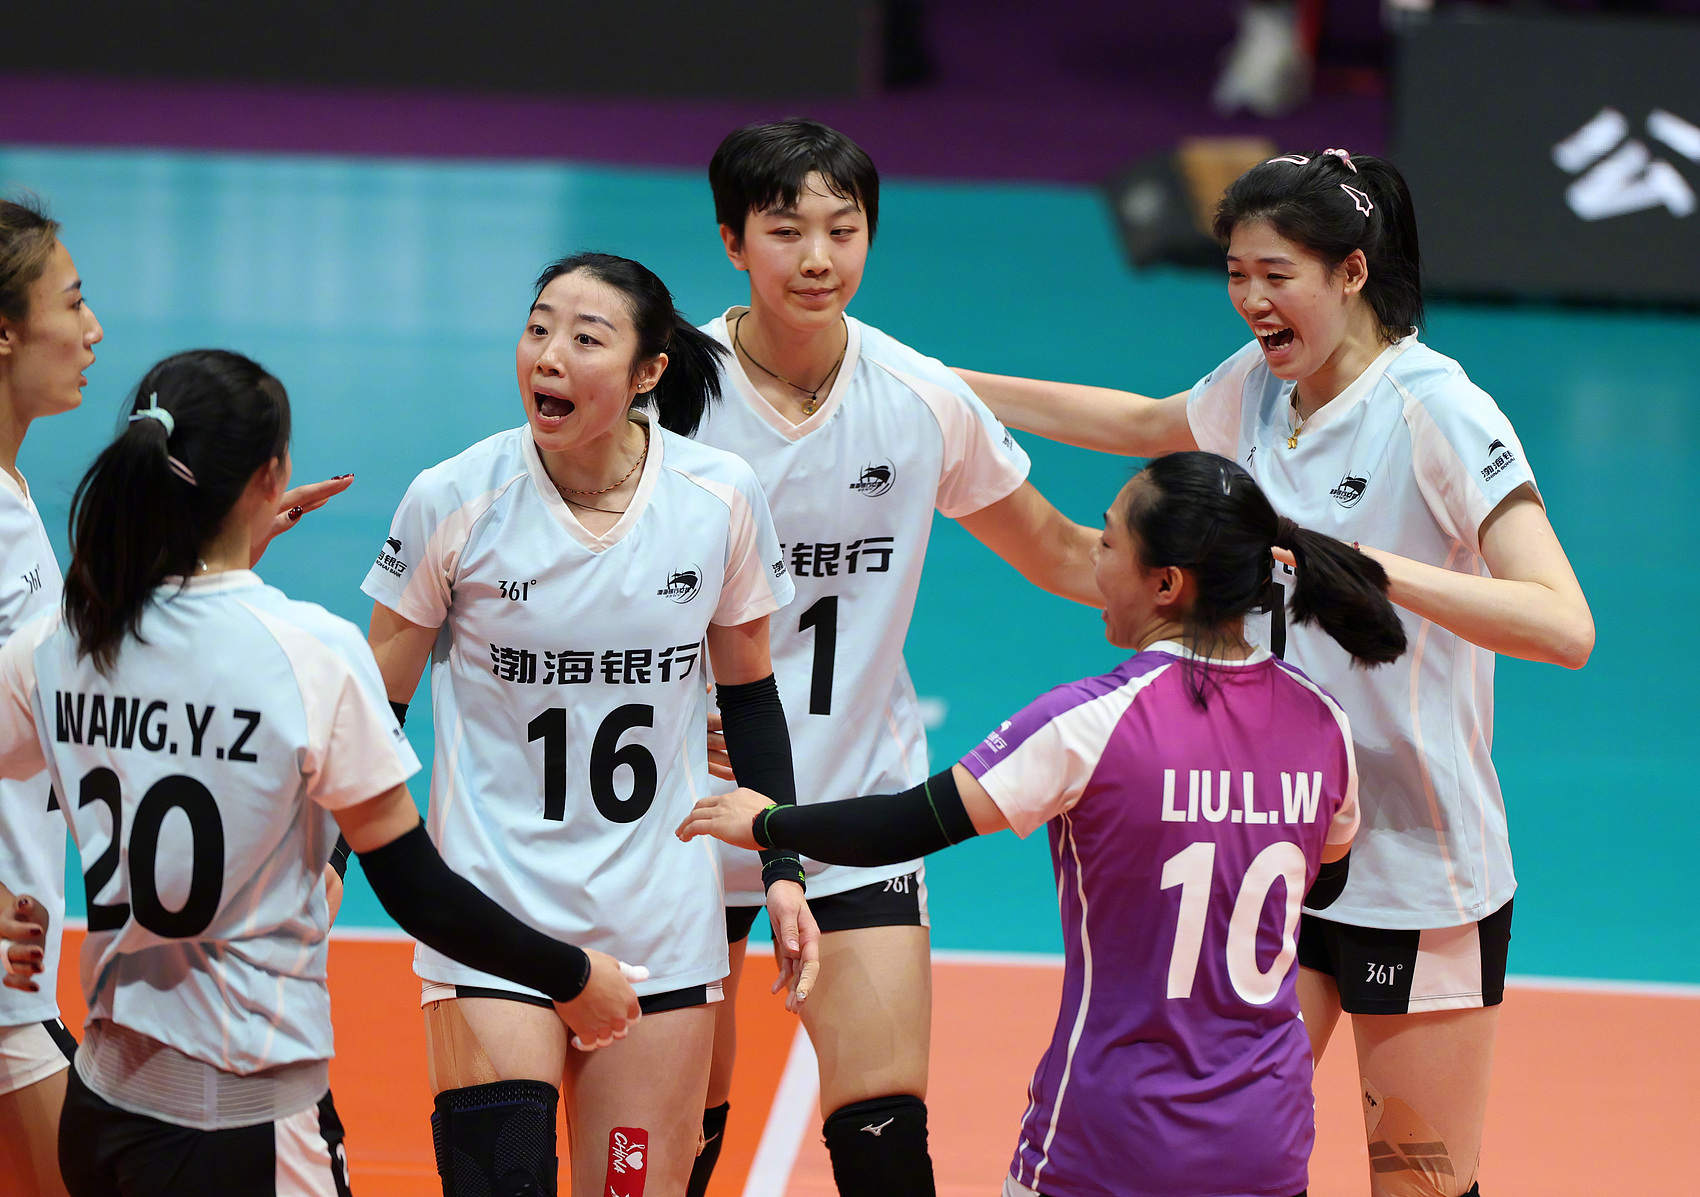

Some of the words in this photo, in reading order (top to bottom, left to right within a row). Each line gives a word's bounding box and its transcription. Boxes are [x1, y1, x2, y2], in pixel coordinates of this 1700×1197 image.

[779, 537, 895, 577] 银行
[489, 643, 701, 685] 渤海银行
[798, 595, 839, 716] 1
[55, 690, 262, 763] WANG.Y.Z
[527, 703, 658, 824] 16
[1161, 768, 1323, 824] LIU.L.W
[78, 766, 226, 938] 20
[1160, 841, 1307, 1006] 10
[612, 1132, 629, 1174] CHINA
